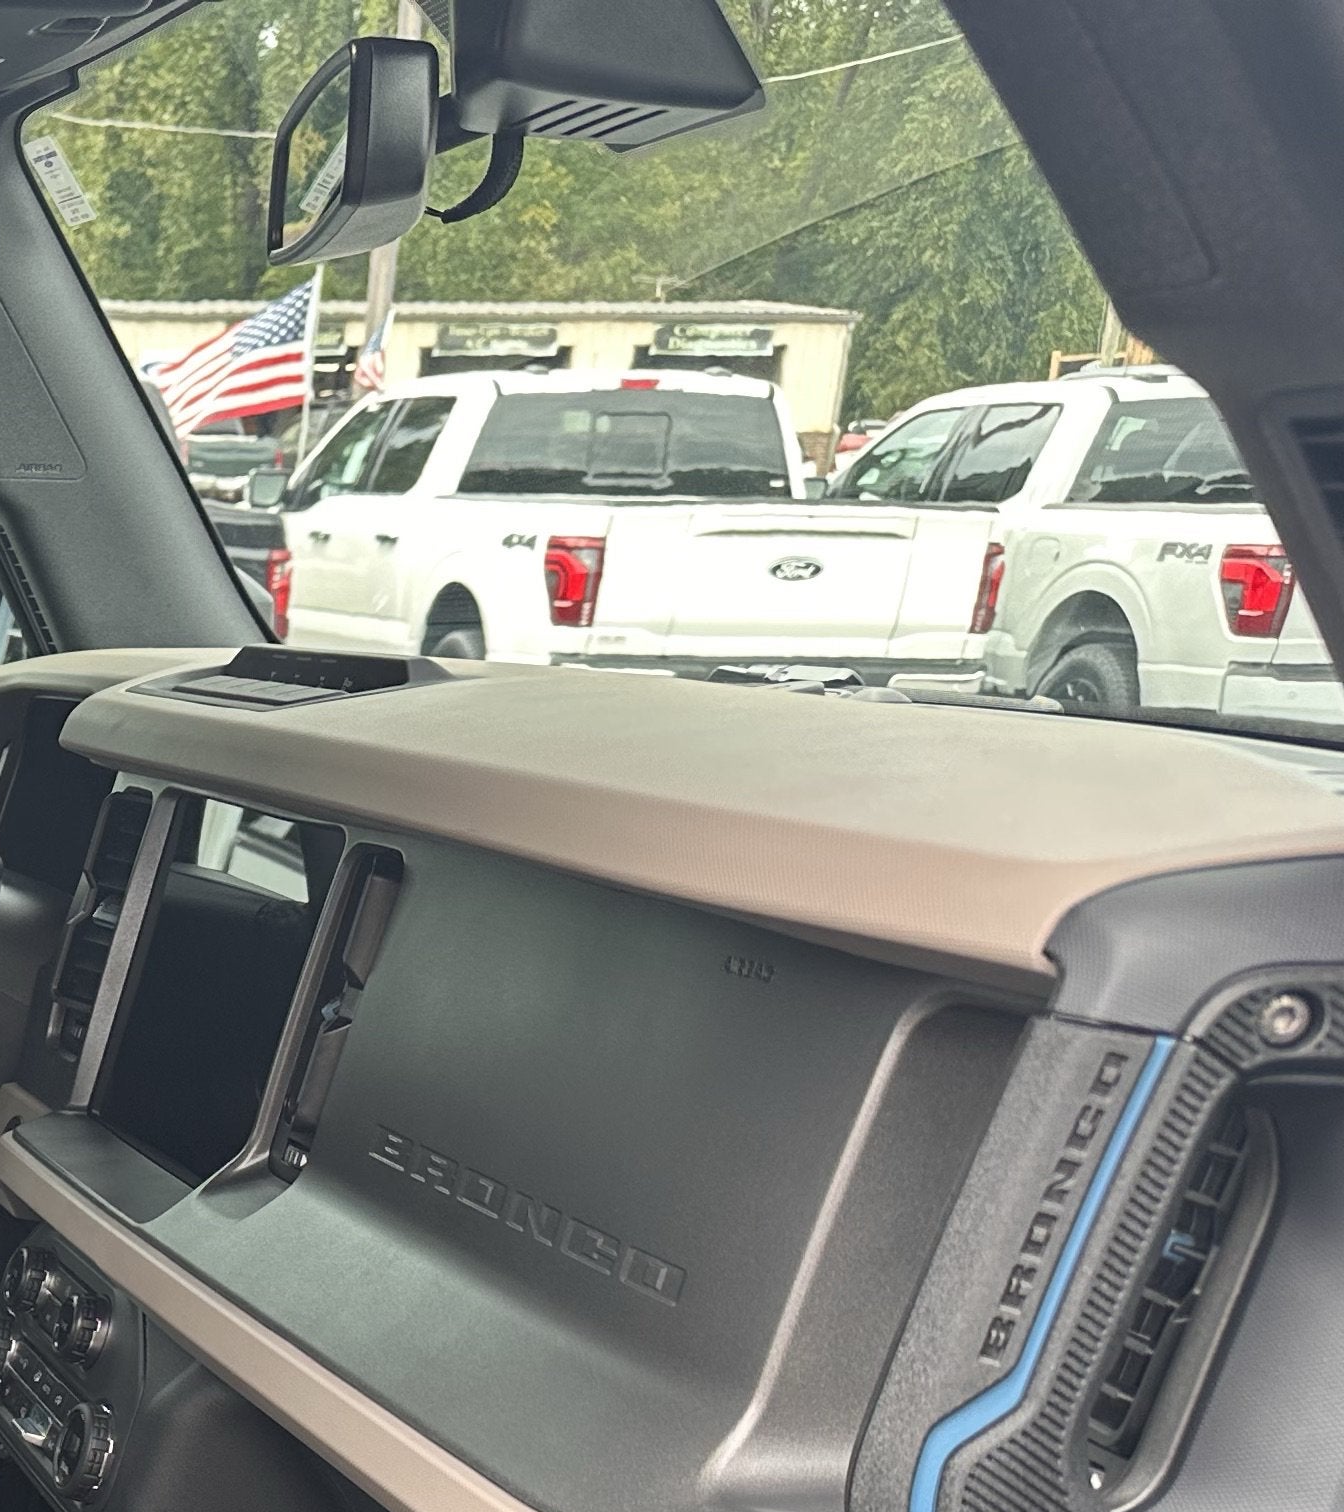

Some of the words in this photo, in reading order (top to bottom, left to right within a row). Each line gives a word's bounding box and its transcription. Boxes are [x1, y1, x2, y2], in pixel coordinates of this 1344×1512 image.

[771, 559, 820, 580] Ford
[1156, 542, 1213, 562] FX4
[368, 1123, 689, 1308] BRONCO
[978, 1051, 1129, 1364] BRONCO
